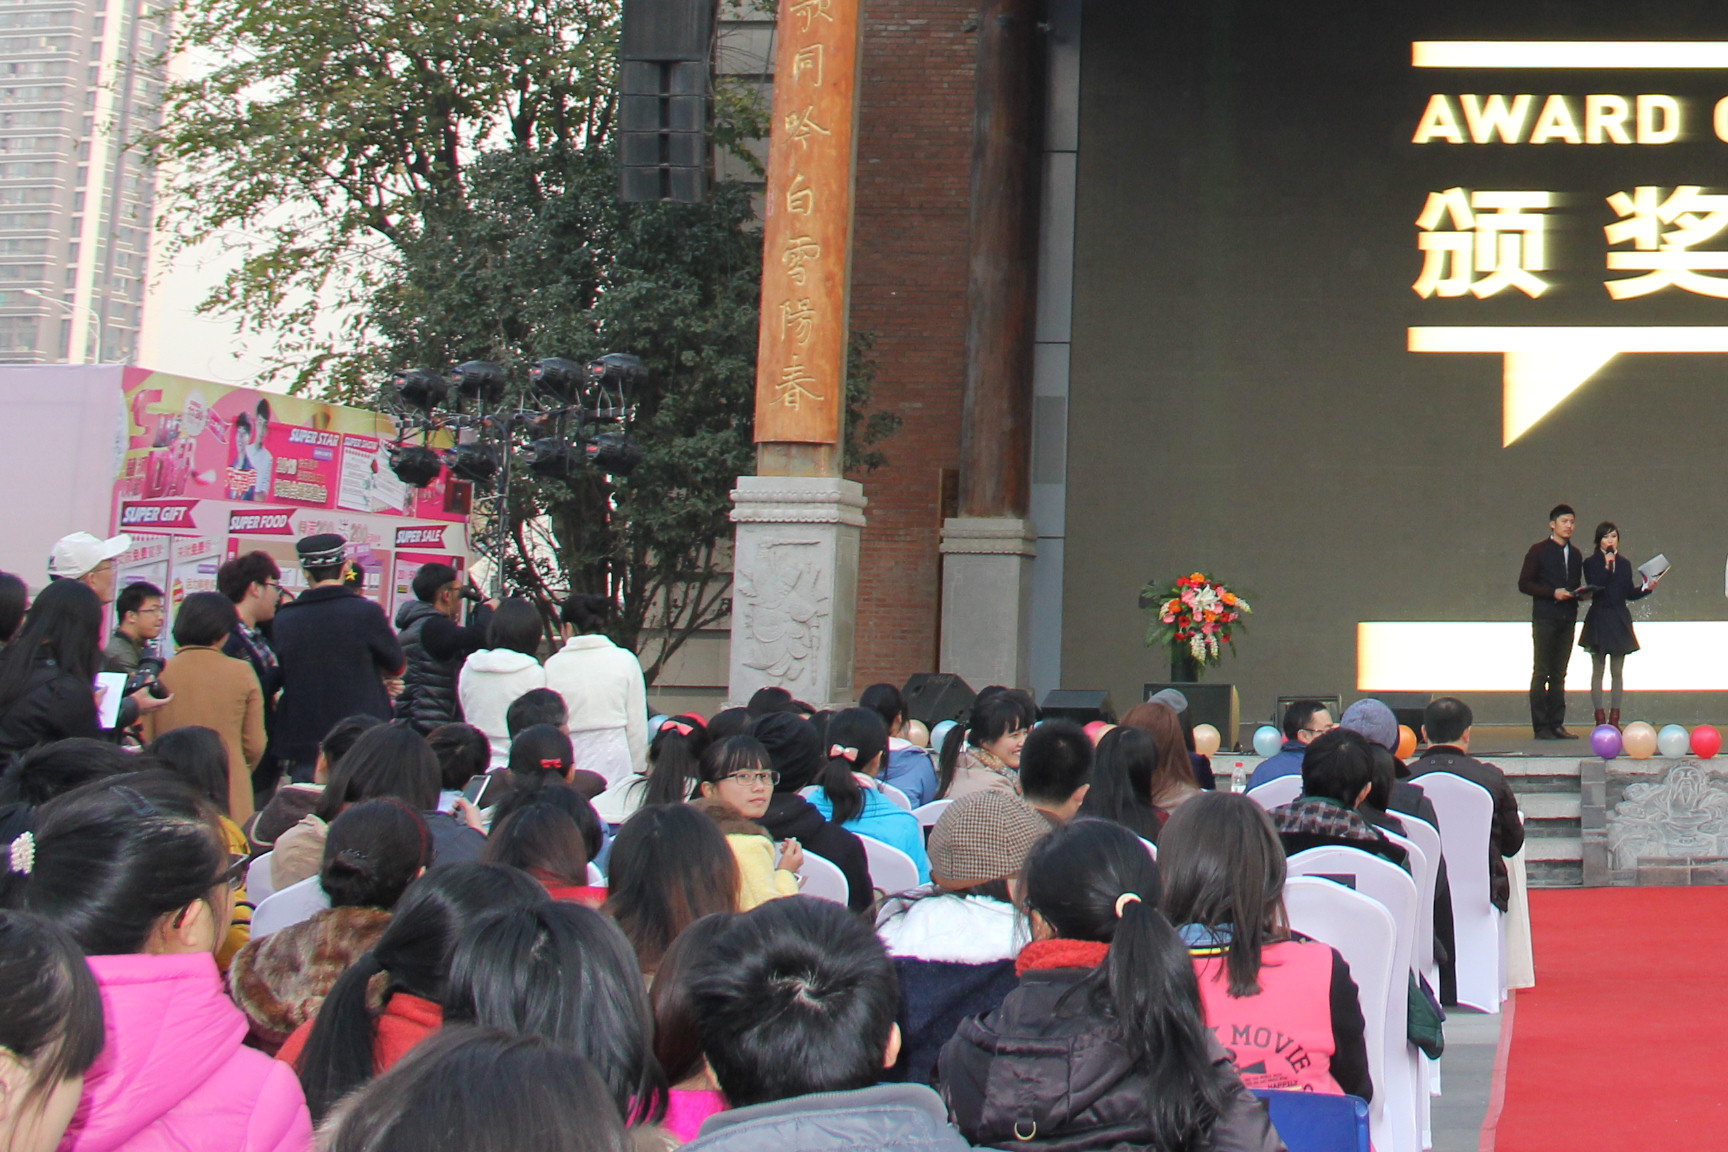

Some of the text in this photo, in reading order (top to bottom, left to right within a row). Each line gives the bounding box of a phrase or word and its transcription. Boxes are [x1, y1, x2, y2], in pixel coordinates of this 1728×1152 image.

[1411, 94, 1682, 145] AWARD
[289, 428, 340, 447] SUPER STAR
[123, 506, 188, 523] SUPER GIFT
[229, 516, 260, 530] SUPER
[260, 515, 288, 529] FOOD
[396, 530, 422, 544] SUPER
[421, 530, 442, 542] SALE
[1230, 1024, 1311, 1074] MOVIE
